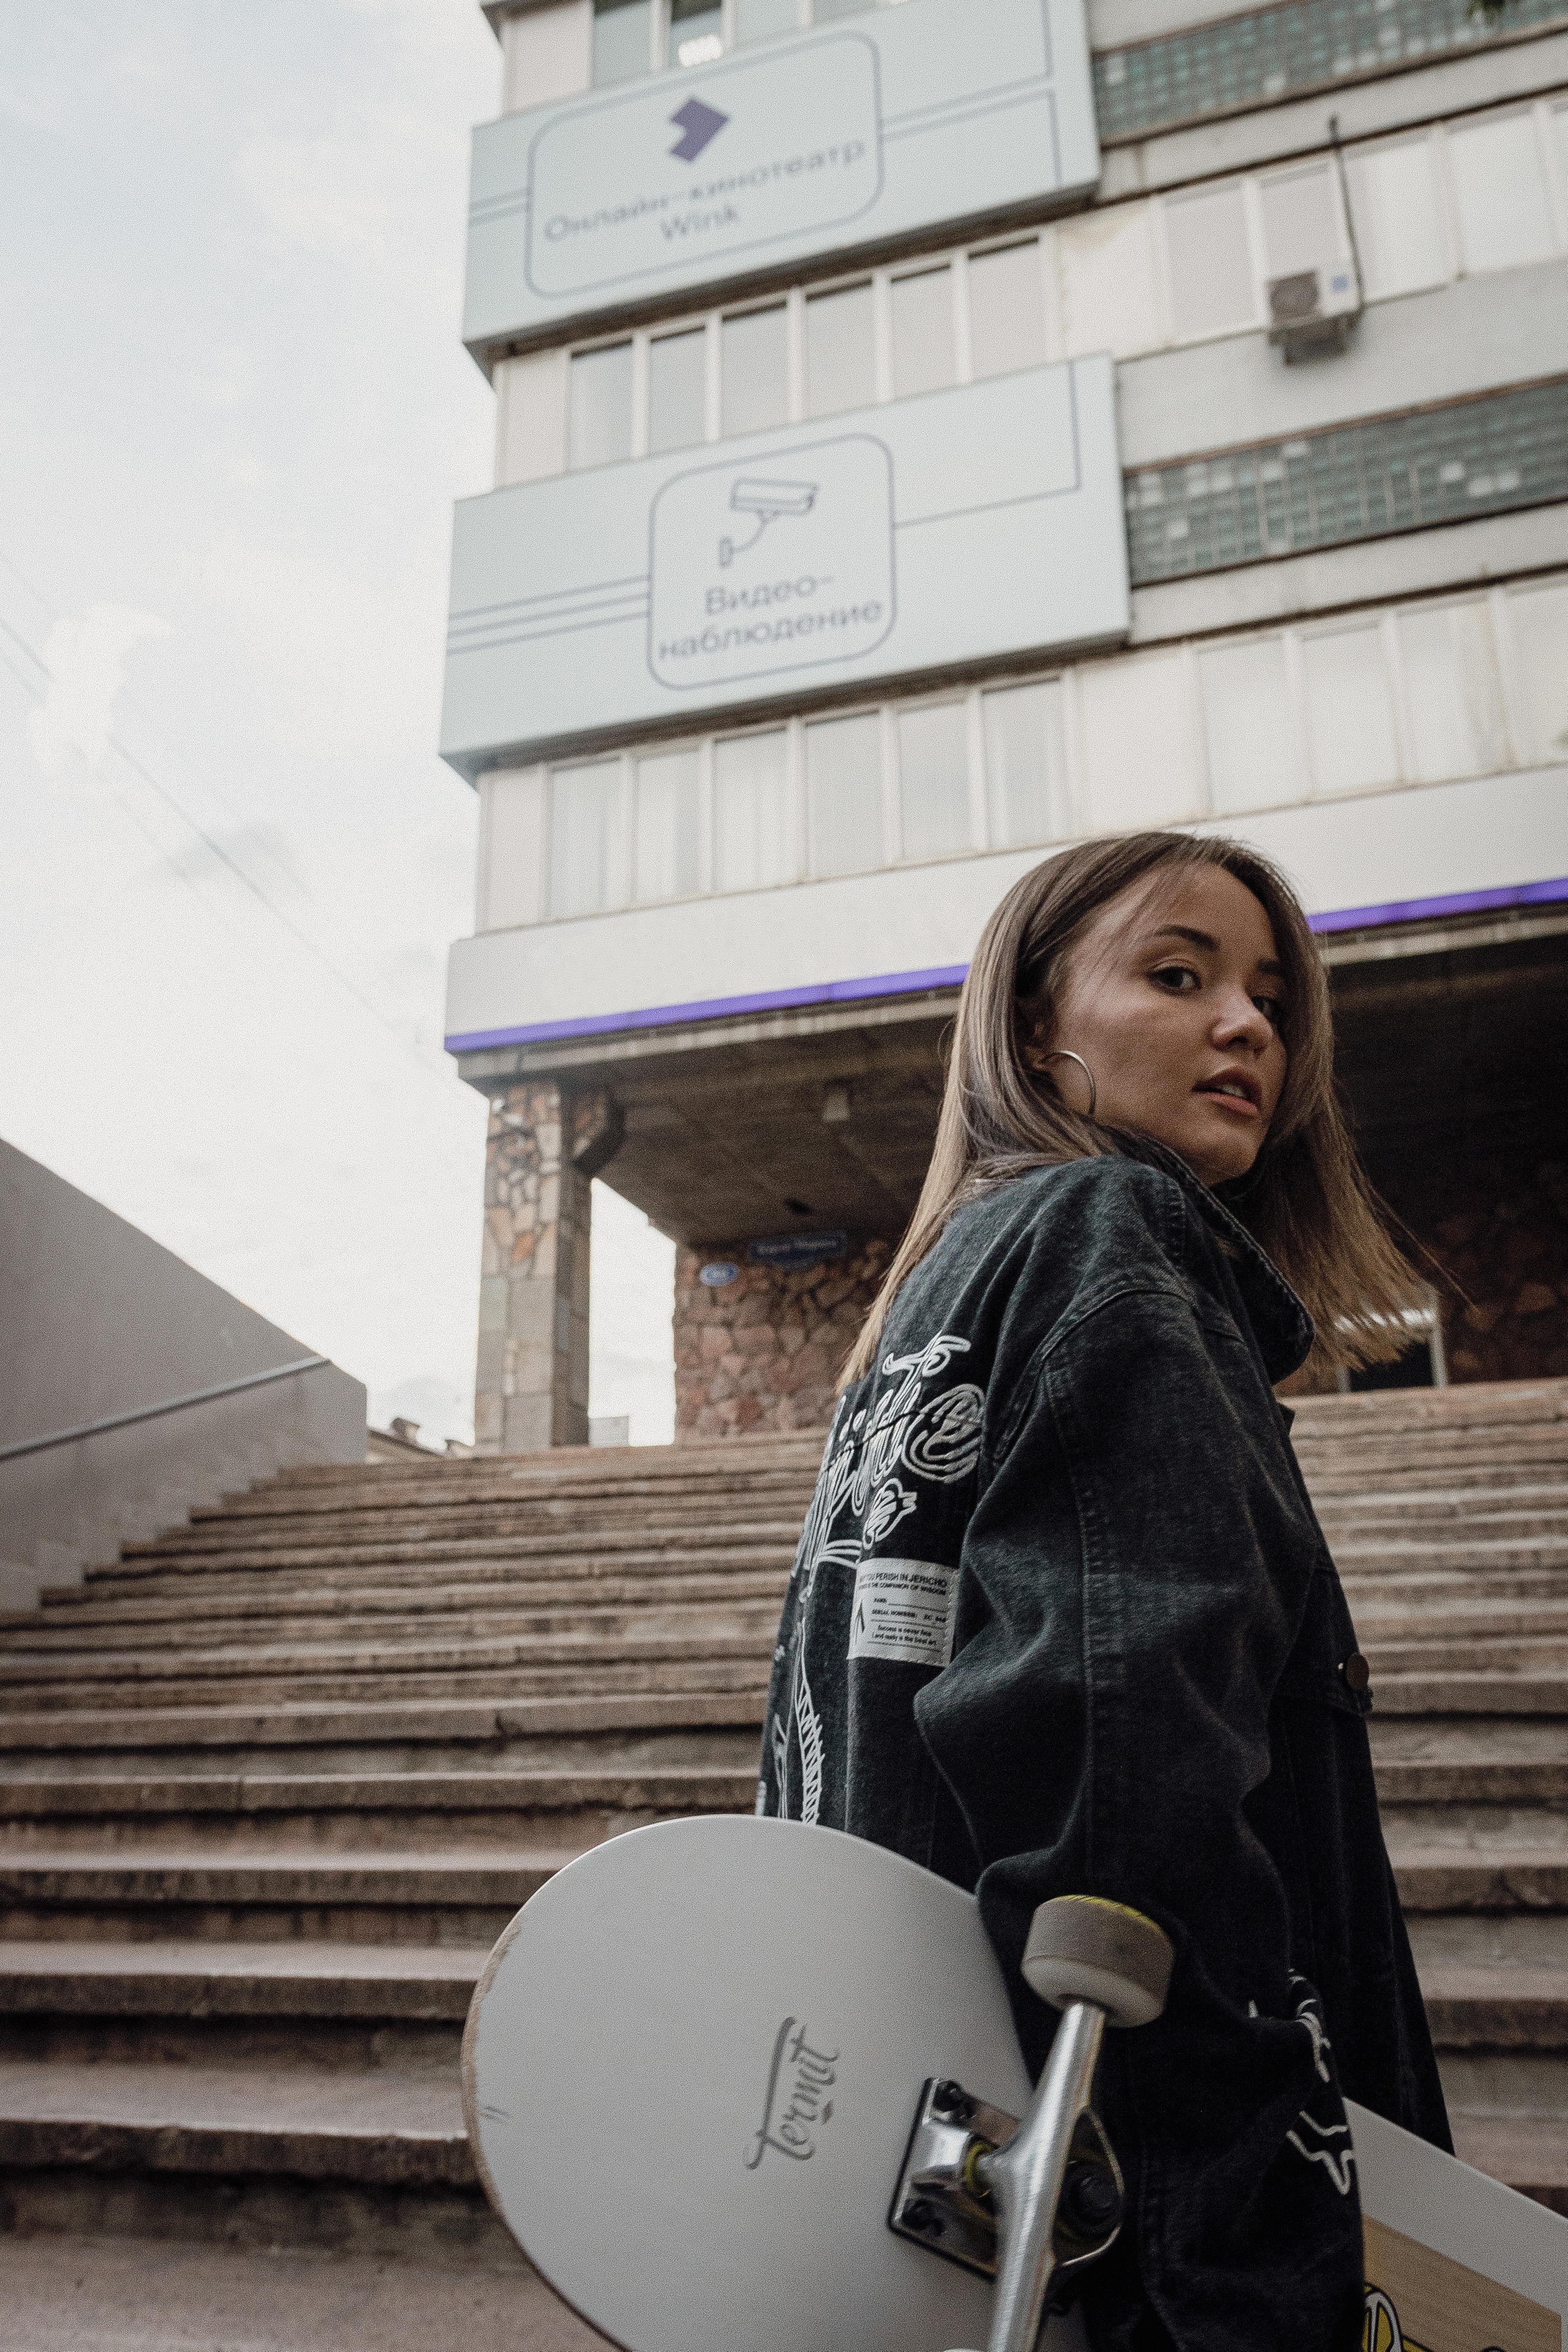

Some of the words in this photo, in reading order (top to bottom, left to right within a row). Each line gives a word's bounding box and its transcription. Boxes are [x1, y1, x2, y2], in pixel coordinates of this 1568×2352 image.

[660, 202, 738, 241] Wink
[705, 573, 837, 617] Видео-
[658, 599, 883, 660] наблюдение
[908, 1574, 948, 1587] JERICHO
[742, 2016, 841, 2170] Termit
